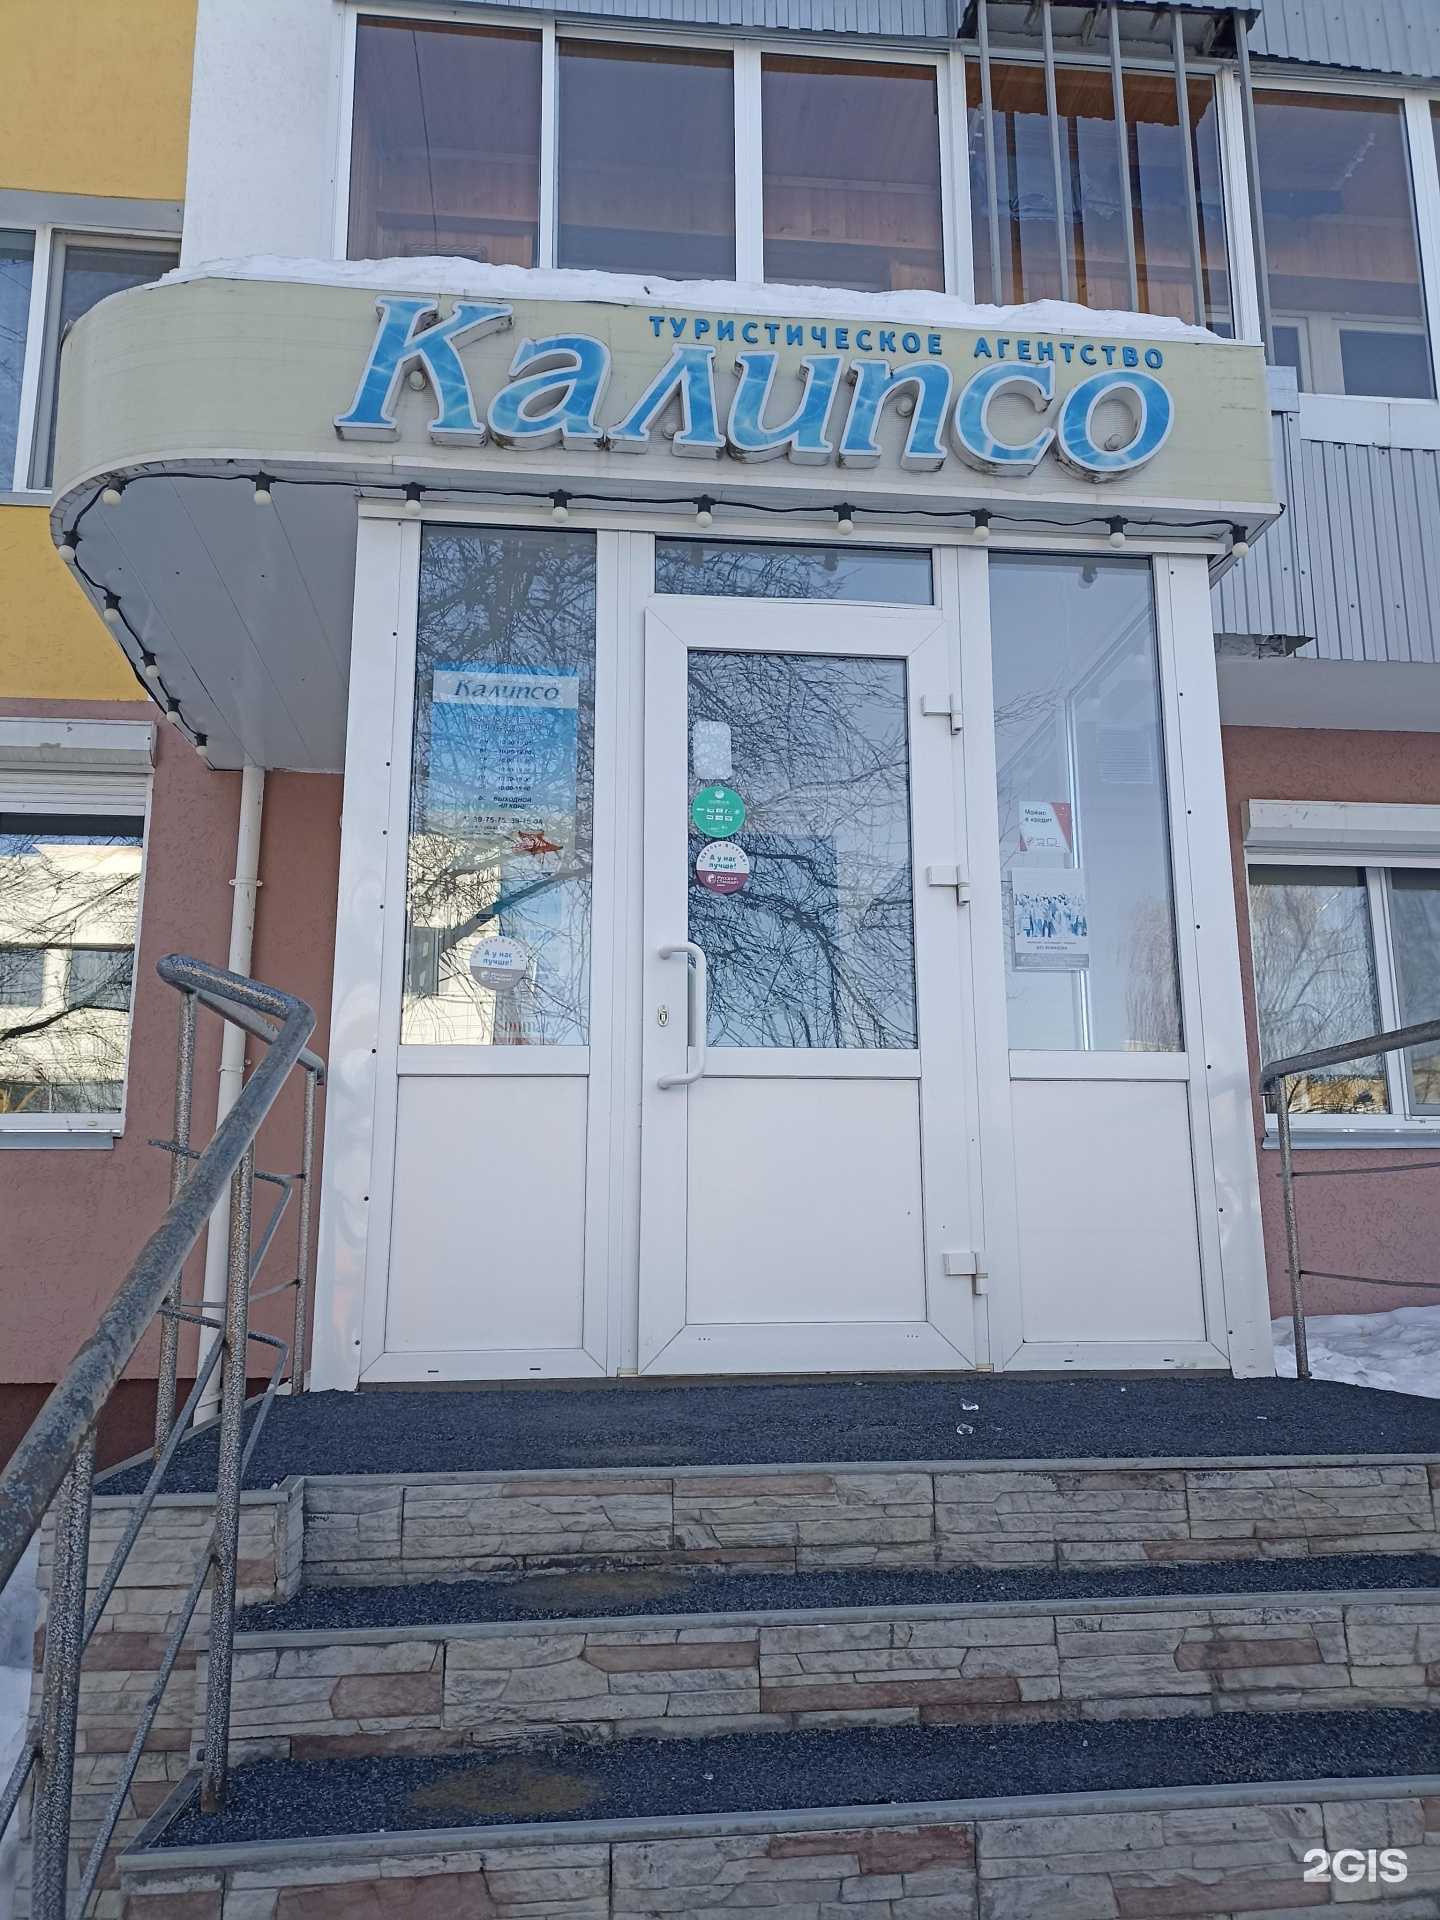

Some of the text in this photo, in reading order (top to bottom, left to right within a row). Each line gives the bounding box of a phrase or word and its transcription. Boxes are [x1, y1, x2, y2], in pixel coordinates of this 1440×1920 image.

[649, 315, 1164, 369] ТУРИСТИЧЕСКОЕ АГЕНТСТВО
[333, 296, 1177, 482] Калипсо
[454, 679, 560, 701] Калипсо
